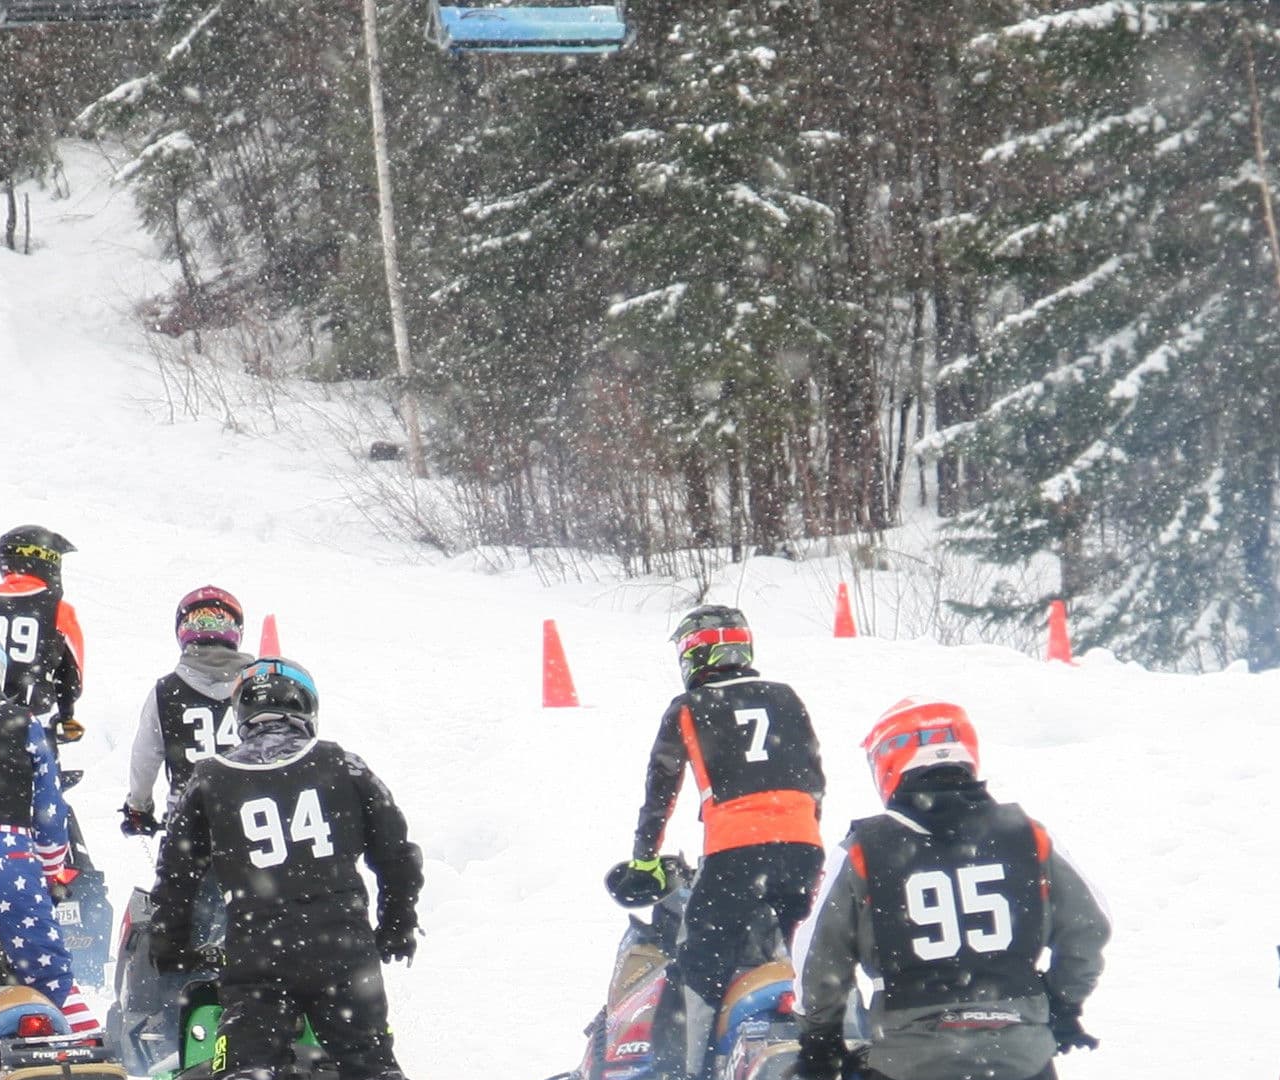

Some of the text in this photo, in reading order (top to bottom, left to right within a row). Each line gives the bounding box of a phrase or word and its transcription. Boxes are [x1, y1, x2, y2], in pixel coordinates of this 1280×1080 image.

[182, 707, 240, 764] 34
[734, 708, 769, 762] 7
[240, 789, 333, 868] 94
[905, 864, 1012, 960] 95
[616, 1042, 650, 1056] FXR
